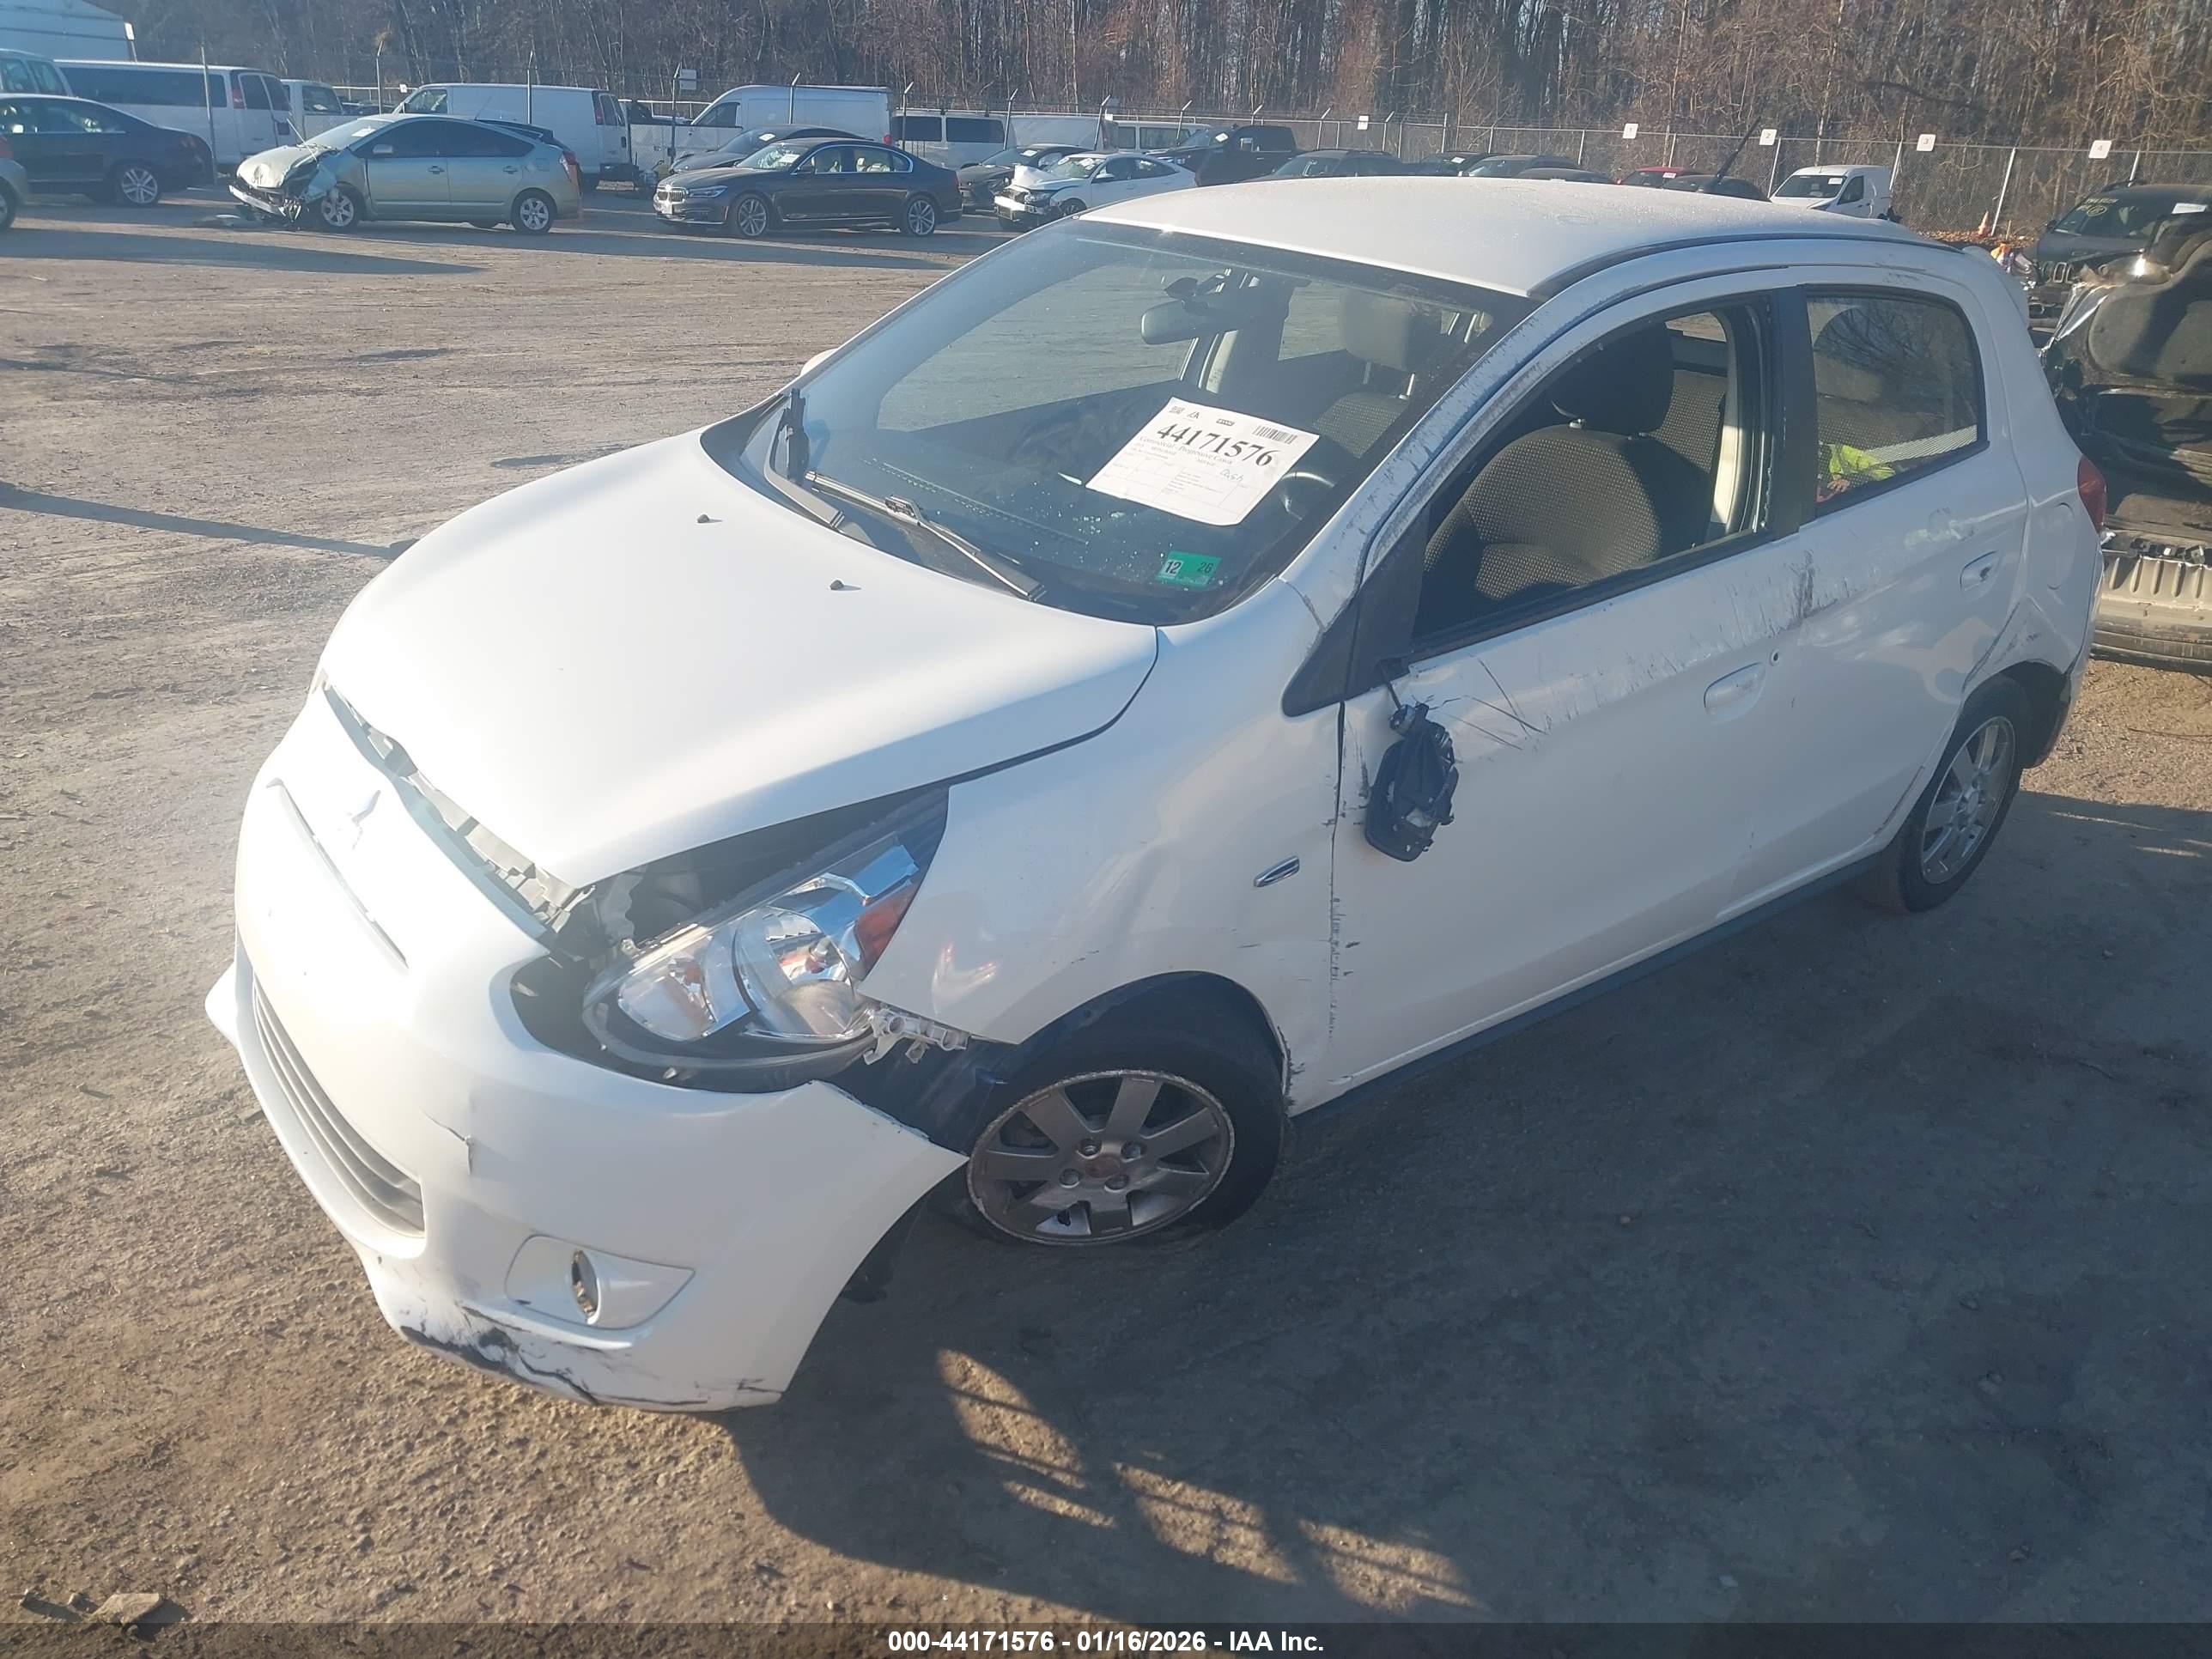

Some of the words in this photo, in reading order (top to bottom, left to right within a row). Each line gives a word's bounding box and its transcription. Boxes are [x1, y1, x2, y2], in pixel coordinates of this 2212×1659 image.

[1157, 422, 1280, 467] 44171576
[1165, 561, 1182, 574] 12
[1197, 562, 1214, 574] 26
